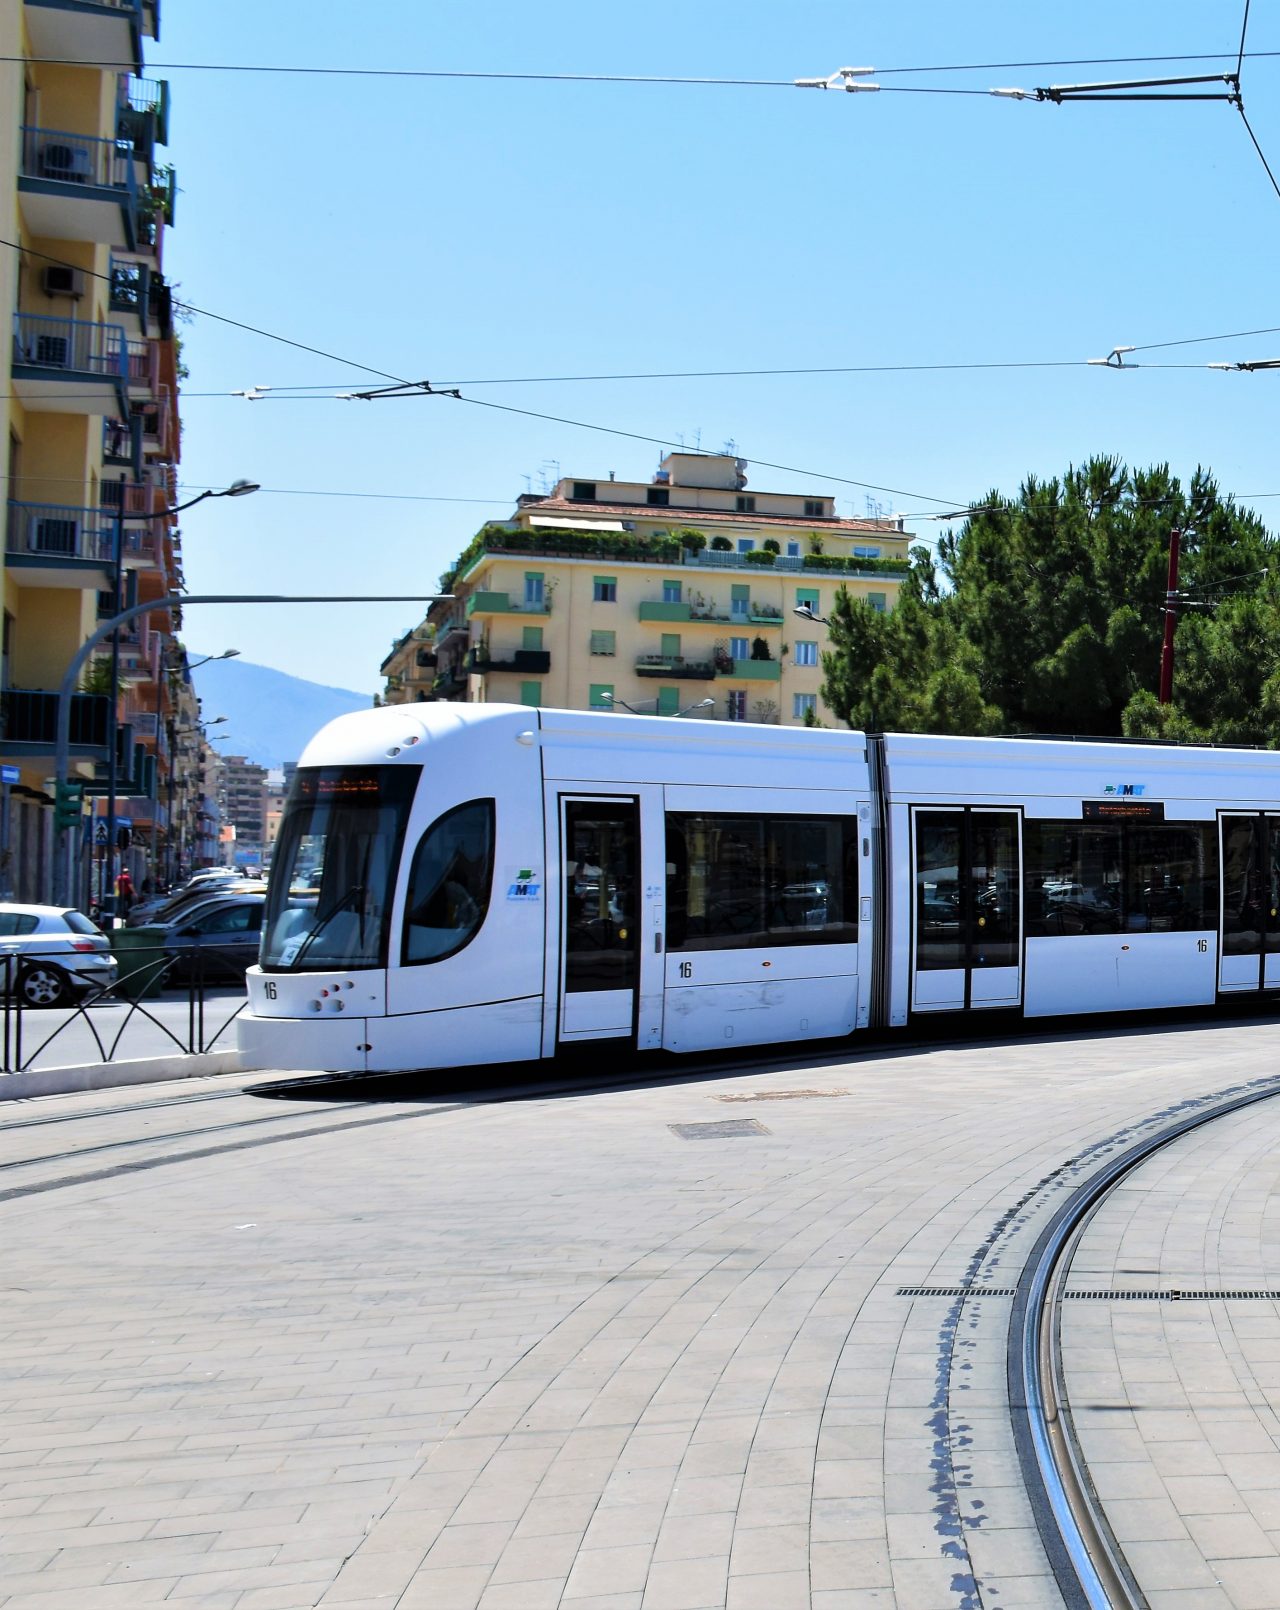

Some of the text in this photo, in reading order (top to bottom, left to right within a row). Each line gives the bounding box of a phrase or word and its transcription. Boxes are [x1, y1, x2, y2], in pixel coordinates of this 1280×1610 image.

[1197, 939, 1208, 952] 16
[679, 961, 693, 979] 16
[264, 981, 278, 1000] 16
